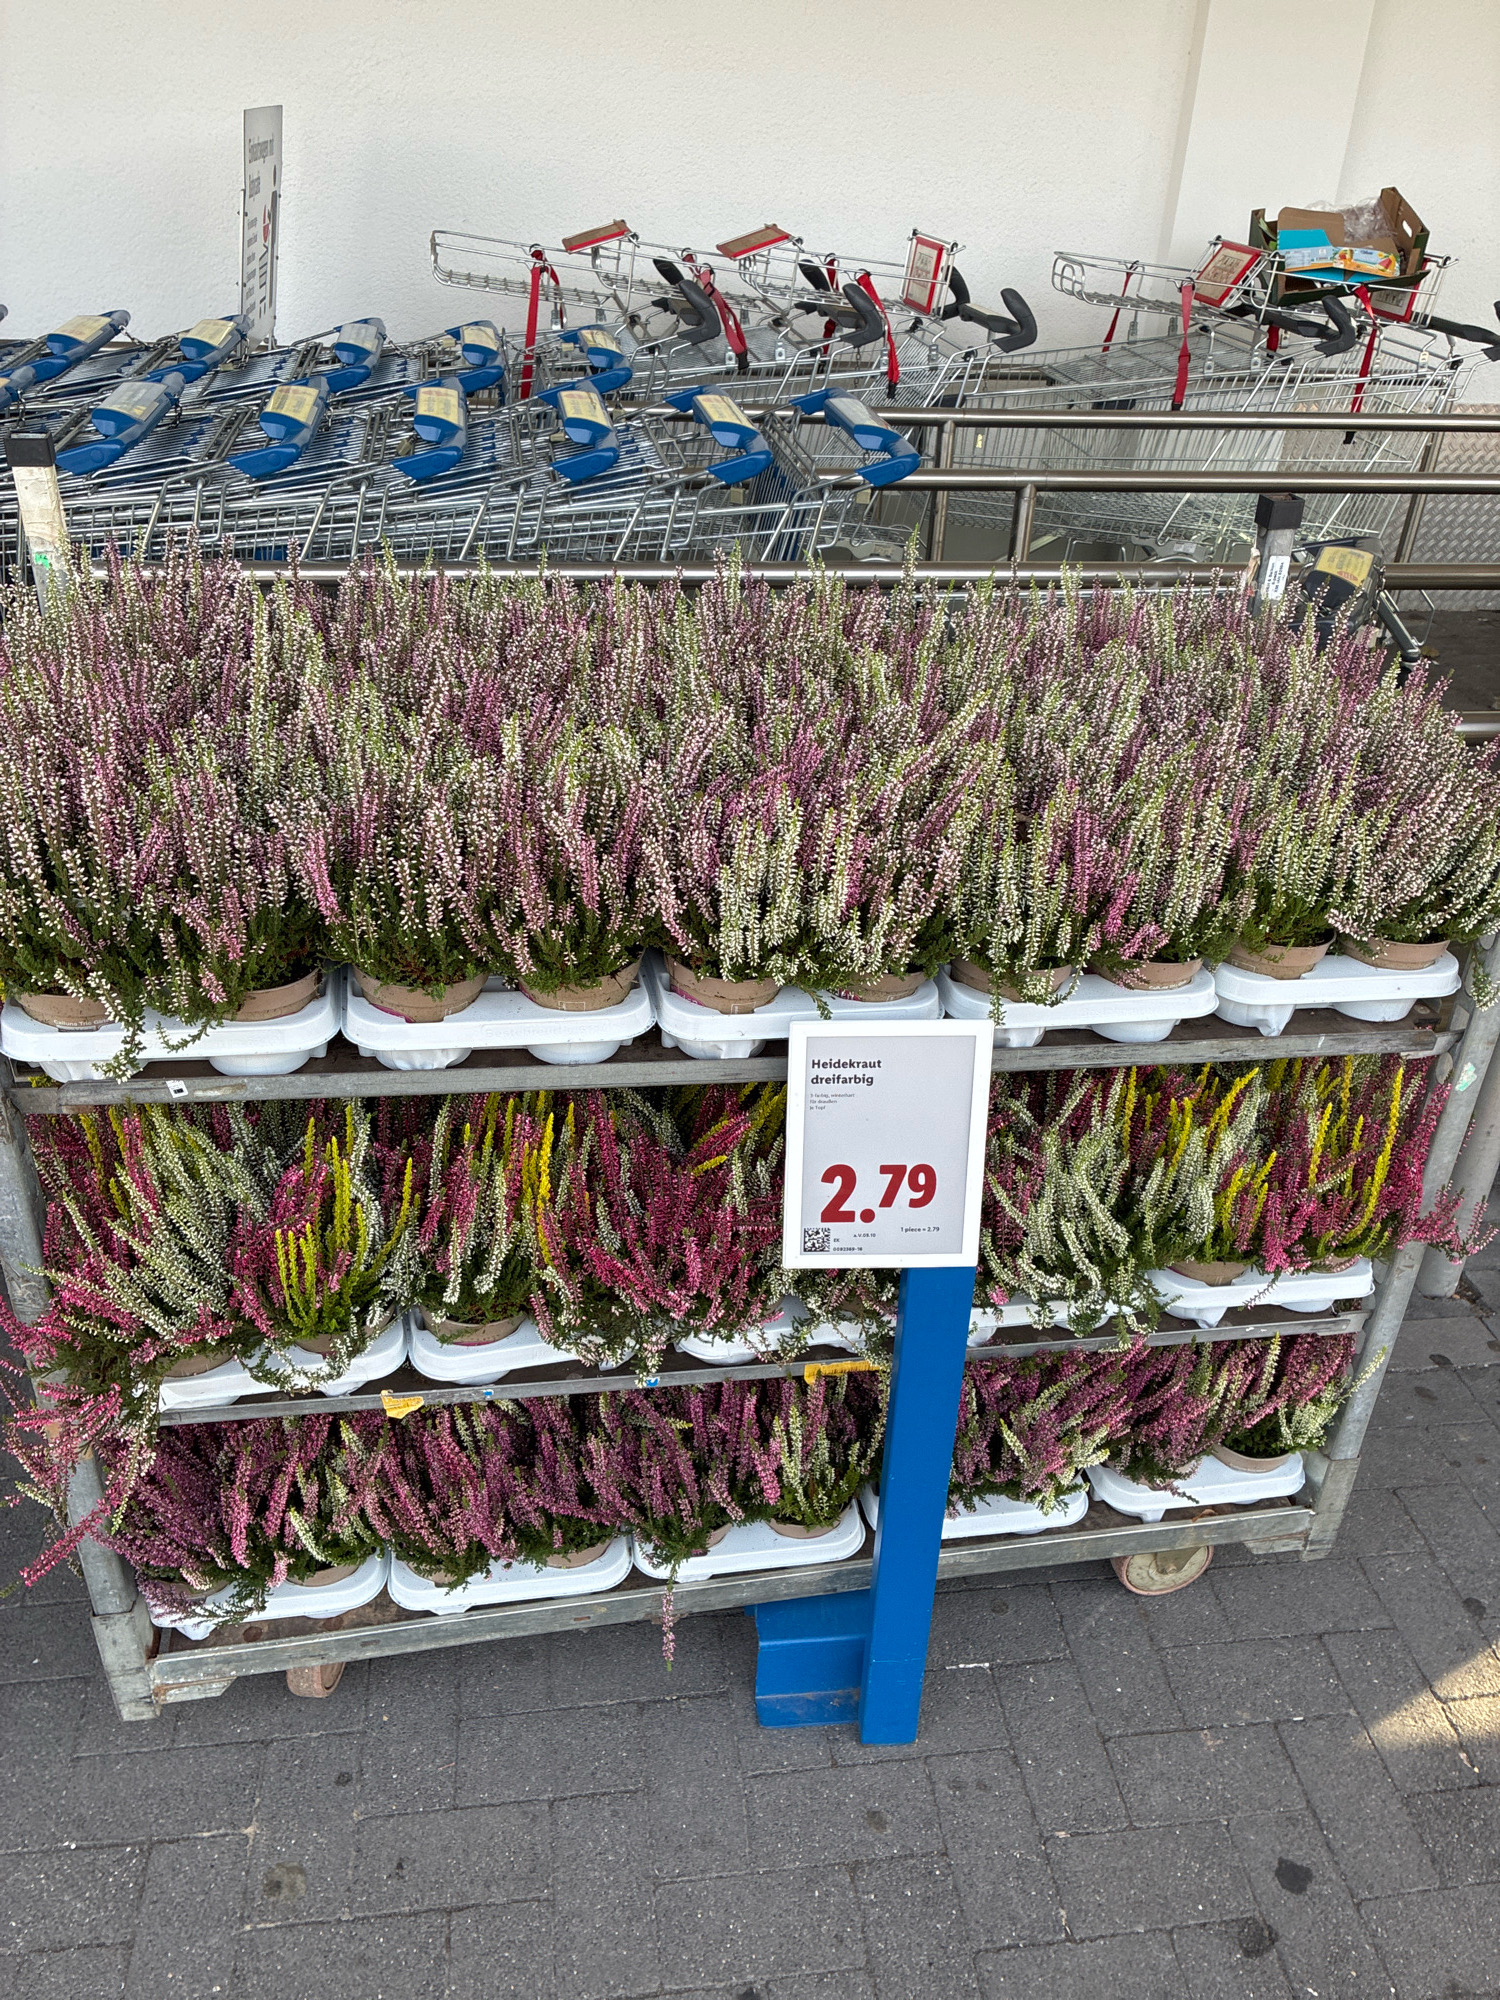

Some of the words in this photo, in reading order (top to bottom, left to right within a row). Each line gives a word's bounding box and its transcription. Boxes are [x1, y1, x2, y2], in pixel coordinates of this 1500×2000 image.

[811, 1058, 882, 1070] Heidekraut
[810, 1073, 874, 1087] dreifarbig
[820, 1163, 937, 1224] 2.79
